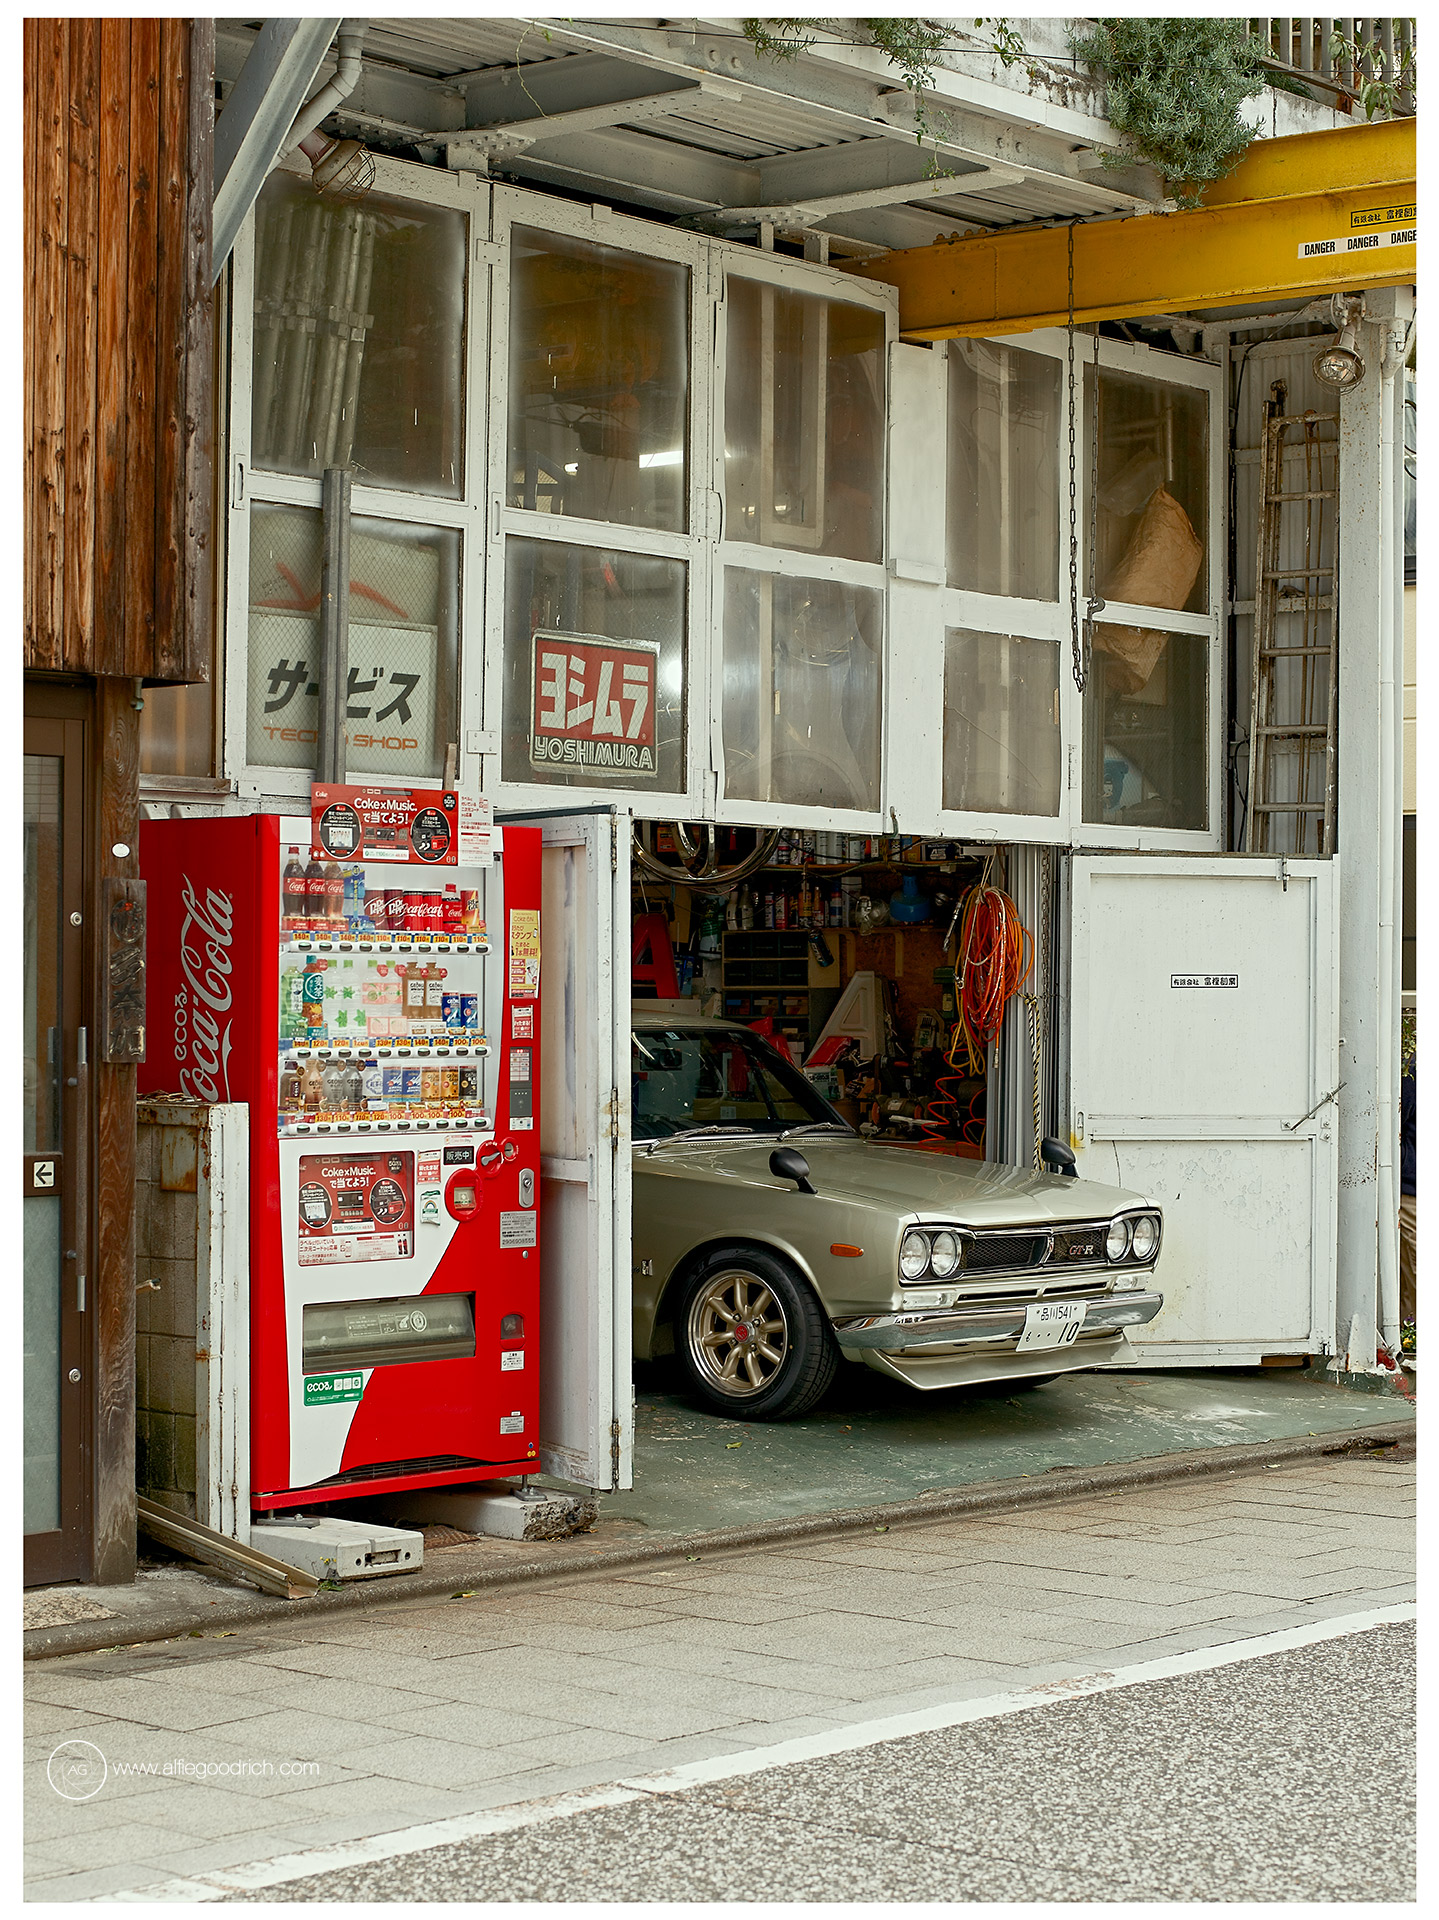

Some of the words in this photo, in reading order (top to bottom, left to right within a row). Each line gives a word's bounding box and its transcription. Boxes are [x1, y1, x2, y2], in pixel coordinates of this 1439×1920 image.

[1304, 241, 1336, 256] DANGER
[1347, 235, 1379, 250] DANGER
[540, 652, 649, 739] ヨシムラ
[353, 734, 418, 750] SHOP
[534, 735, 653, 769] YOSHIMURA
[446, 1151, 470, 1161] 販売中
[1058, 1321, 1080, 1344] 10
